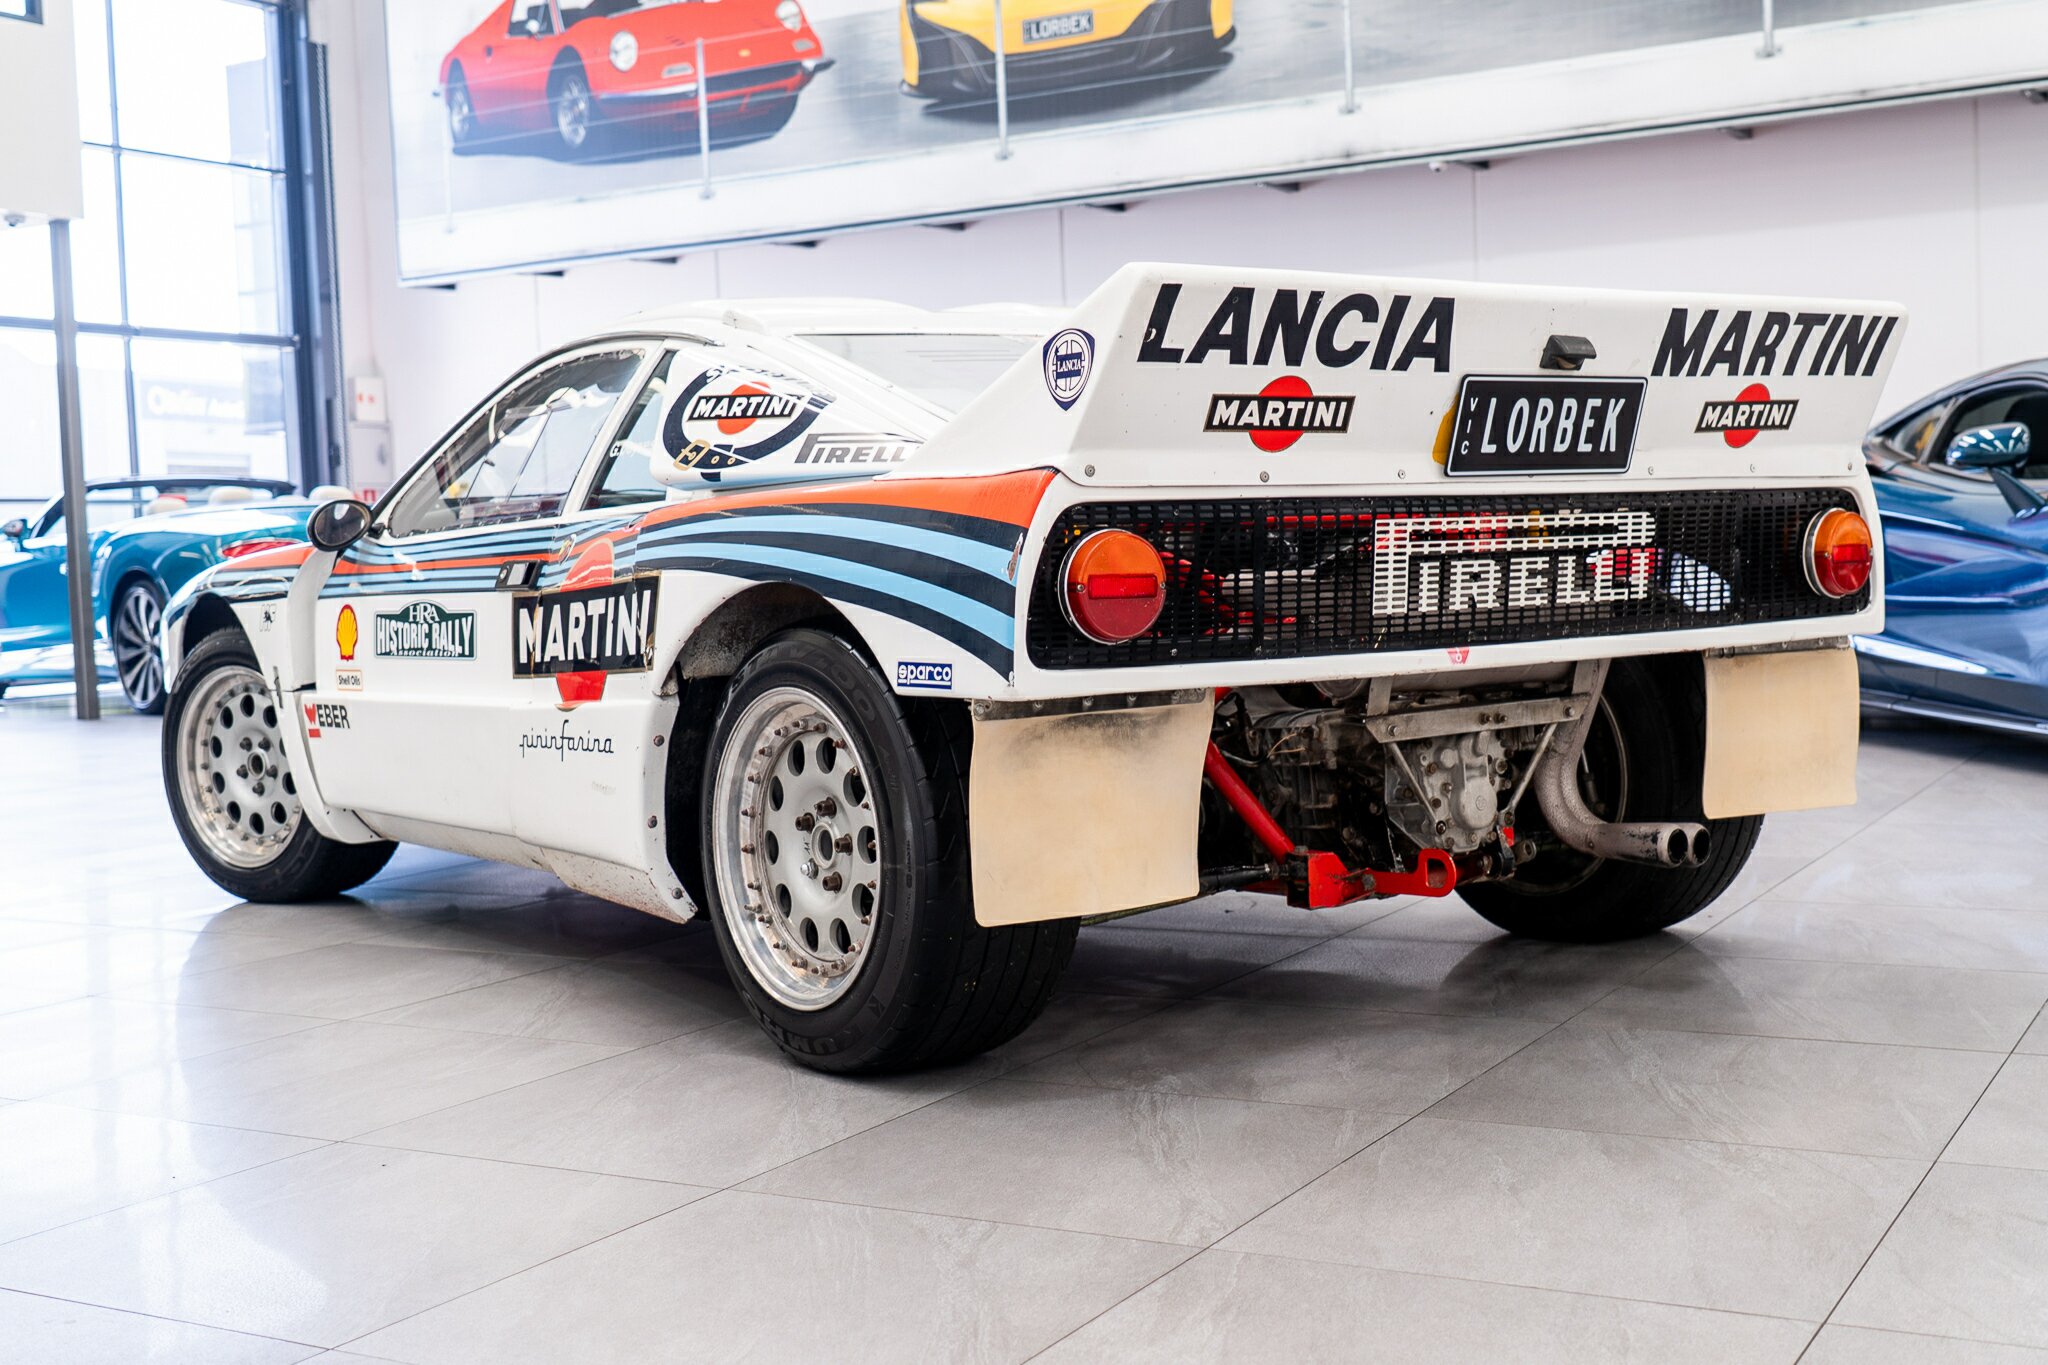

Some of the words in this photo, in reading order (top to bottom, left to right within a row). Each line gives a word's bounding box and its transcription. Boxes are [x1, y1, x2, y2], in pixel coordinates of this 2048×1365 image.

[1030, 14, 1091, 39] LORBEK
[1137, 283, 1455, 372] LANCIA
[1651, 308, 1899, 377] MARTINI
[1057, 358, 1081, 372] LANCIA
[692, 394, 799, 419] MARTINI
[1212, 400, 1347, 428] MARTINI
[1701, 404, 1793, 428] MARTINI
[1481, 397, 1626, 454] LORBEK
[794, 432, 923, 463] PIRELL
[1372, 511, 1655, 615] PIRELLI
[408, 603, 440, 623] HRA
[519, 590, 653, 663] MARTINI
[377, 616, 429, 654] HISTORIC
[431, 615, 473, 656] RALLY
[390, 648, 460, 657] Association
[338, 675, 350, 685] Shell
[351, 675, 361, 685] Oils
[898, 664, 951, 685] sparco
[304, 703, 350, 729] WEBER
[519, 719, 614, 762] pininfarina
